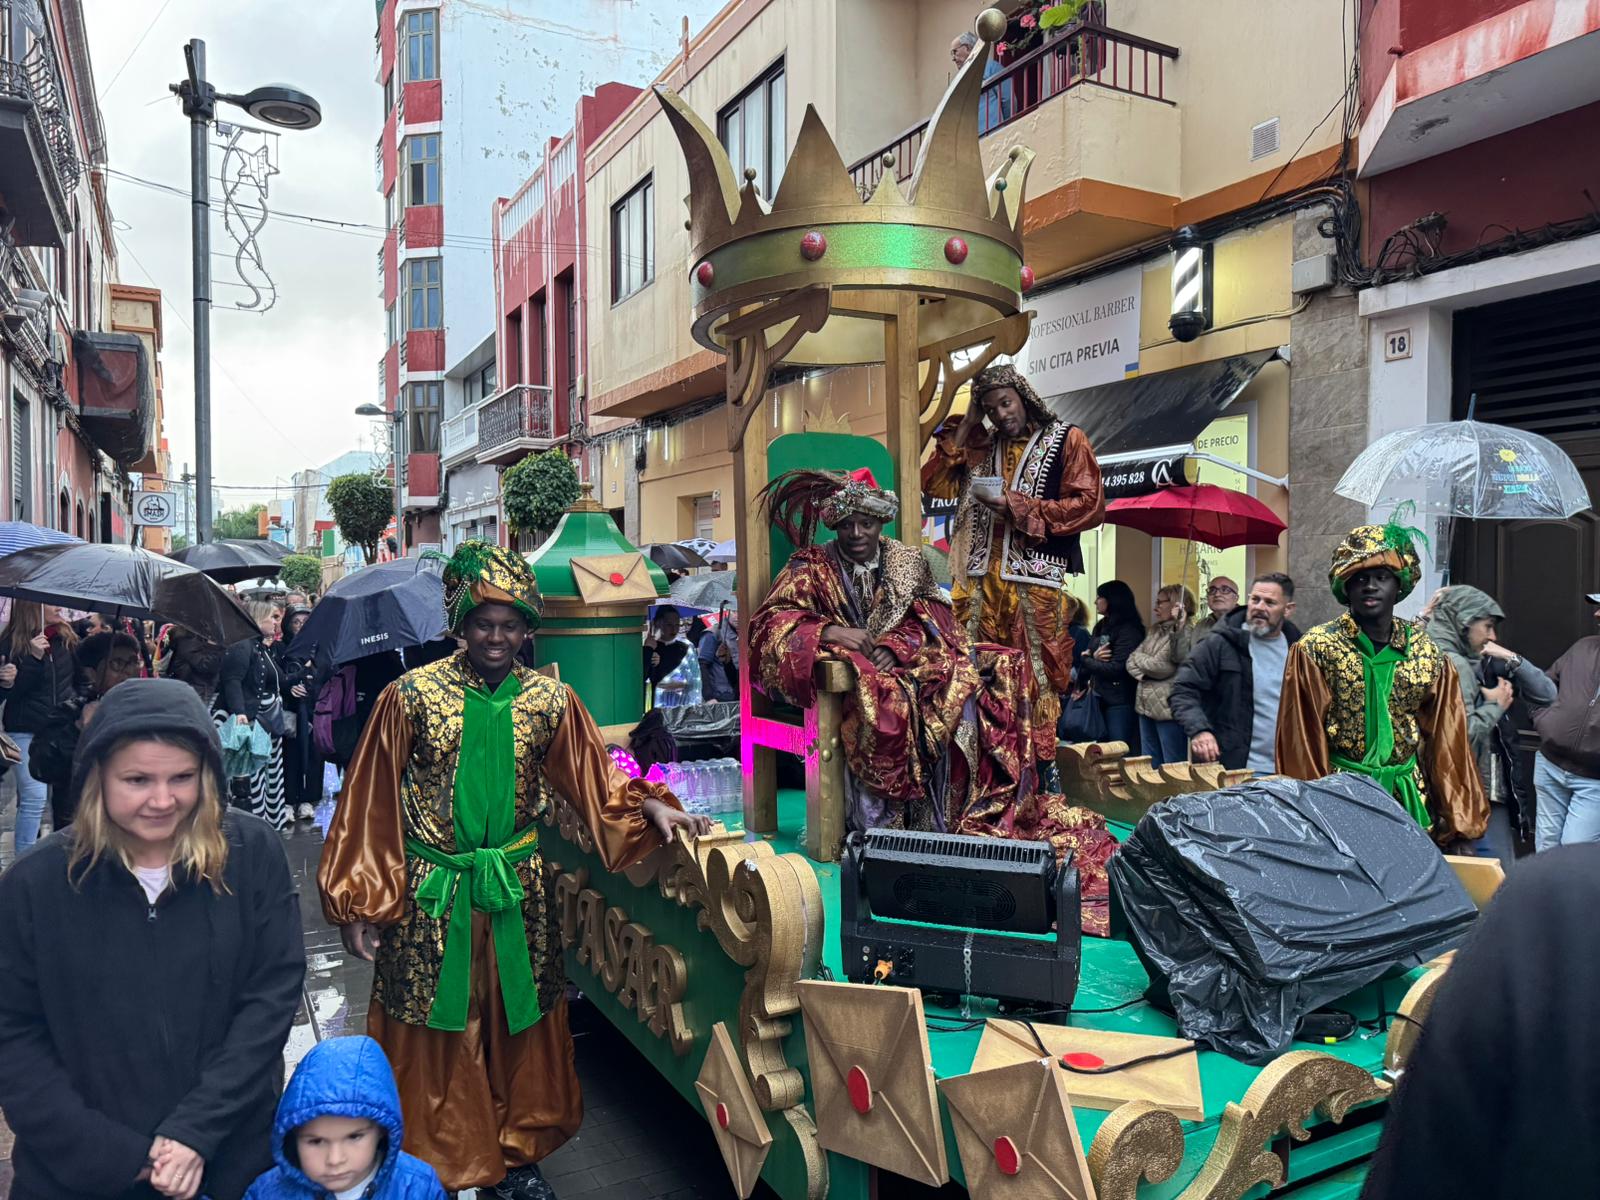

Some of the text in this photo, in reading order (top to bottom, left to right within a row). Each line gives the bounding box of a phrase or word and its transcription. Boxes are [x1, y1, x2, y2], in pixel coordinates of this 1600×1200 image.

[1030, 295, 1136, 340] ROFESSIONAL BARBER
[1390, 336, 1406, 354] 18
[1029, 338, 1120, 375] SIN CITA PREVIA
[1198, 434, 1239, 449] DE PRECIO
[1111, 474, 1128, 487] 395
[1128, 471, 1145, 485] 828
[361, 632, 389, 645] INESIS
